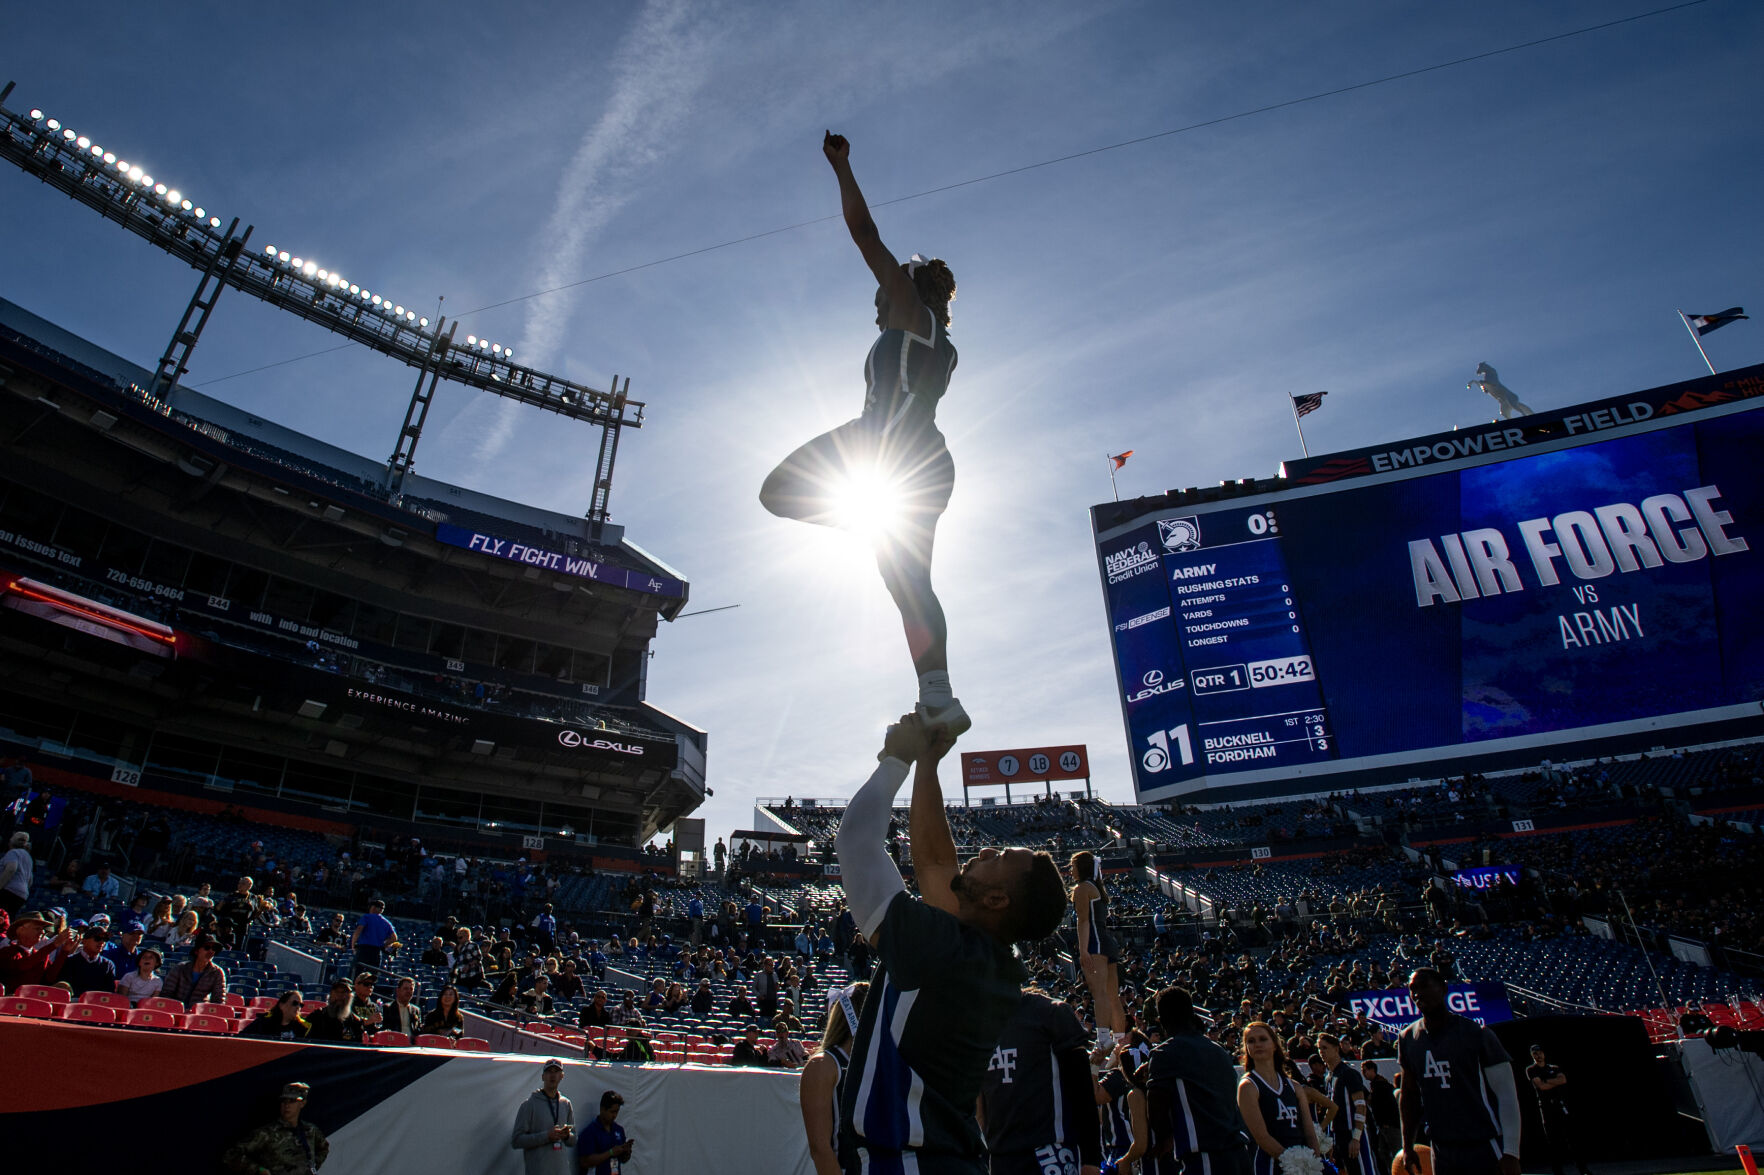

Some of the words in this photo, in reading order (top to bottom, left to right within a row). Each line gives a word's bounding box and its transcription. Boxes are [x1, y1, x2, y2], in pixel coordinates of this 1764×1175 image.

[1371, 428, 1527, 473] EMPOWER
[1563, 402, 1655, 436] FIELD
[1247, 513, 1268, 535] 0
[469, 532, 503, 556] FLY.
[508, 543, 563, 569] FIGHT.
[565, 557, 598, 579] WIN.
[1105, 545, 1136, 564] NAVY
[1407, 527, 1524, 607] AIR
[1517, 485, 1750, 588] FORCE
[1106, 549, 1158, 574] FEDERAL
[1109, 569, 1134, 585] Credit
[1134, 561, 1159, 578] Union
[1173, 563, 1217, 580] ARMY
[1178, 581, 1225, 595] RUSHING
[1225, 575, 1259, 588] STATS
[1180, 594, 1226, 607] ATTEMPTS
[1282, 584, 1289, 593] 0
[1572, 584, 1600, 605] VS
[57, 550, 83, 568] text
[106, 567, 185, 601] 720-650-6464
[250, 610, 273, 626] with
[300, 624, 319, 639] and
[319, 630, 359, 649] location
[1183, 609, 1213, 621] YARDS
[1285, 597, 1293, 607] 0
[1115, 622, 1128, 633] FSI
[1129, 607, 1170, 629] DEFENSE
[1185, 618, 1249, 634] TOUCHDOWNS
[1289, 611, 1296, 620] 0
[1558, 603, 1644, 650] ARMY
[1188, 635, 1229, 648] LONGEST
[1292, 624, 1300, 634] 0
[1195, 674, 1226, 688] QTR
[1230, 669, 1242, 687] 1
[1252, 660, 1311, 683] 50:42
[1126, 678, 1185, 703] LEXUS
[347, 688, 417, 712] EXPERIENCE
[420, 706, 470, 724] AMAZING
[1284, 717, 1299, 727] 1ST
[1304, 714, 1325, 724] 2:30
[582, 737, 645, 756] LEXUS
[1146, 723, 1194, 771] 11
[1204, 731, 1275, 750] BUCKNELL
[1314, 725, 1325, 736] 3
[1207, 746, 1277, 764] FORDHAM
[1317, 739, 1328, 750] 3
[1004, 759, 1012, 772] 7
[1033, 757, 1047, 771] 18
[1062, 755, 1077, 768] 44
[115, 770, 138, 784] 128
[1515, 821, 1532, 830] 131
[526, 838, 543, 849] 128
[1254, 848, 1269, 857] 130
[825, 864, 840, 874] 129
[1423, 1050, 1451, 1088] AF
